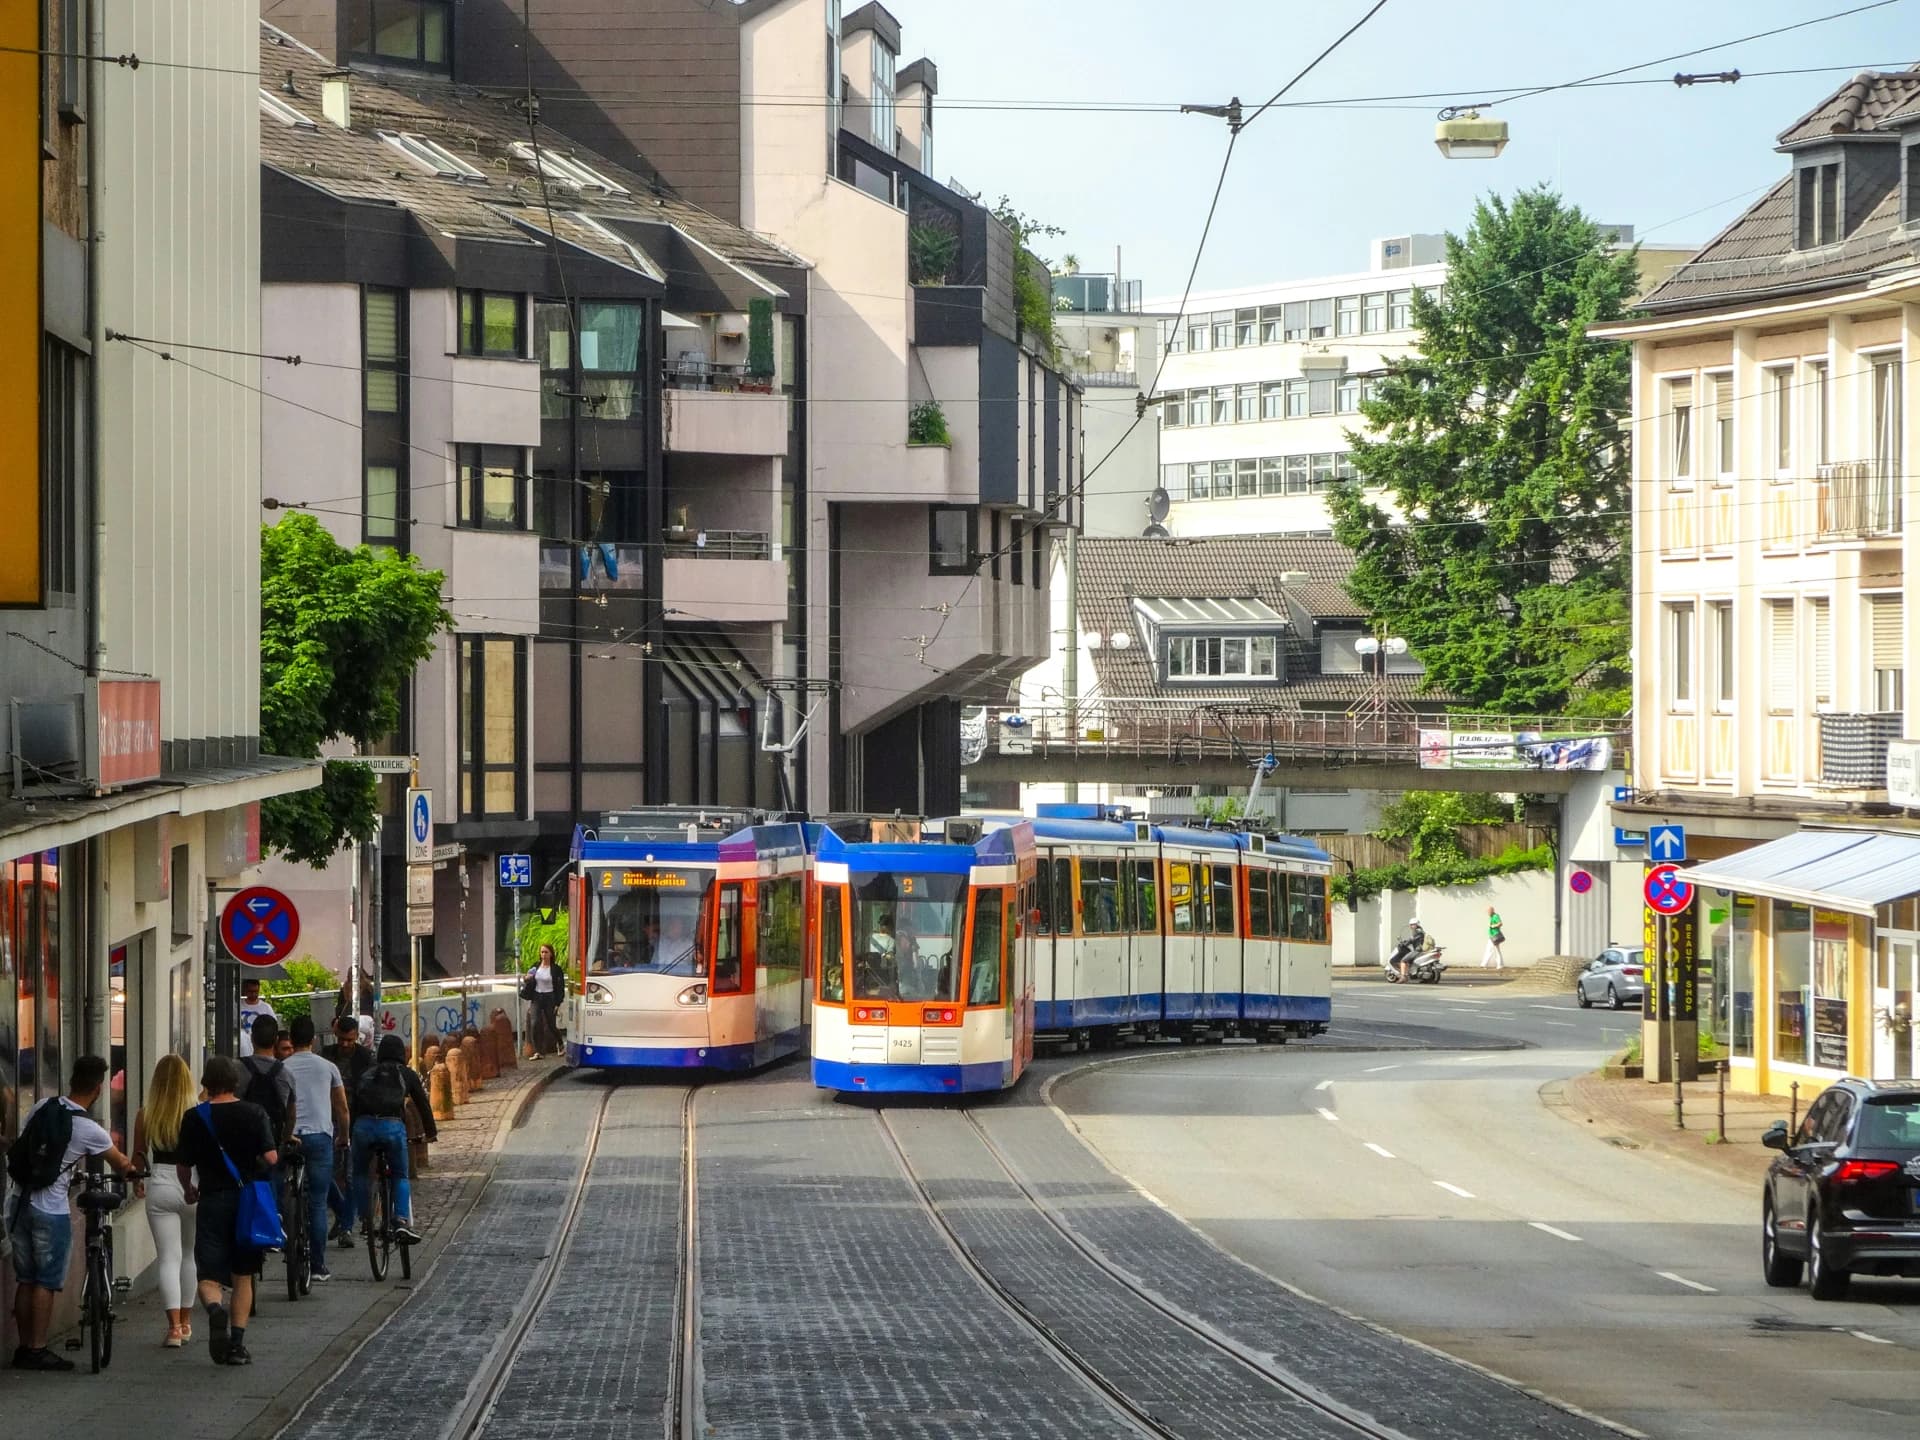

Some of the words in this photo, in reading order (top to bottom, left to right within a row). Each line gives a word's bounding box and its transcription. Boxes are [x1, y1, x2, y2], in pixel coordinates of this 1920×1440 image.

[415, 846, 428, 858] ZONE
[602, 871, 613, 888] 2
[893, 1039, 913, 1048] 9425
